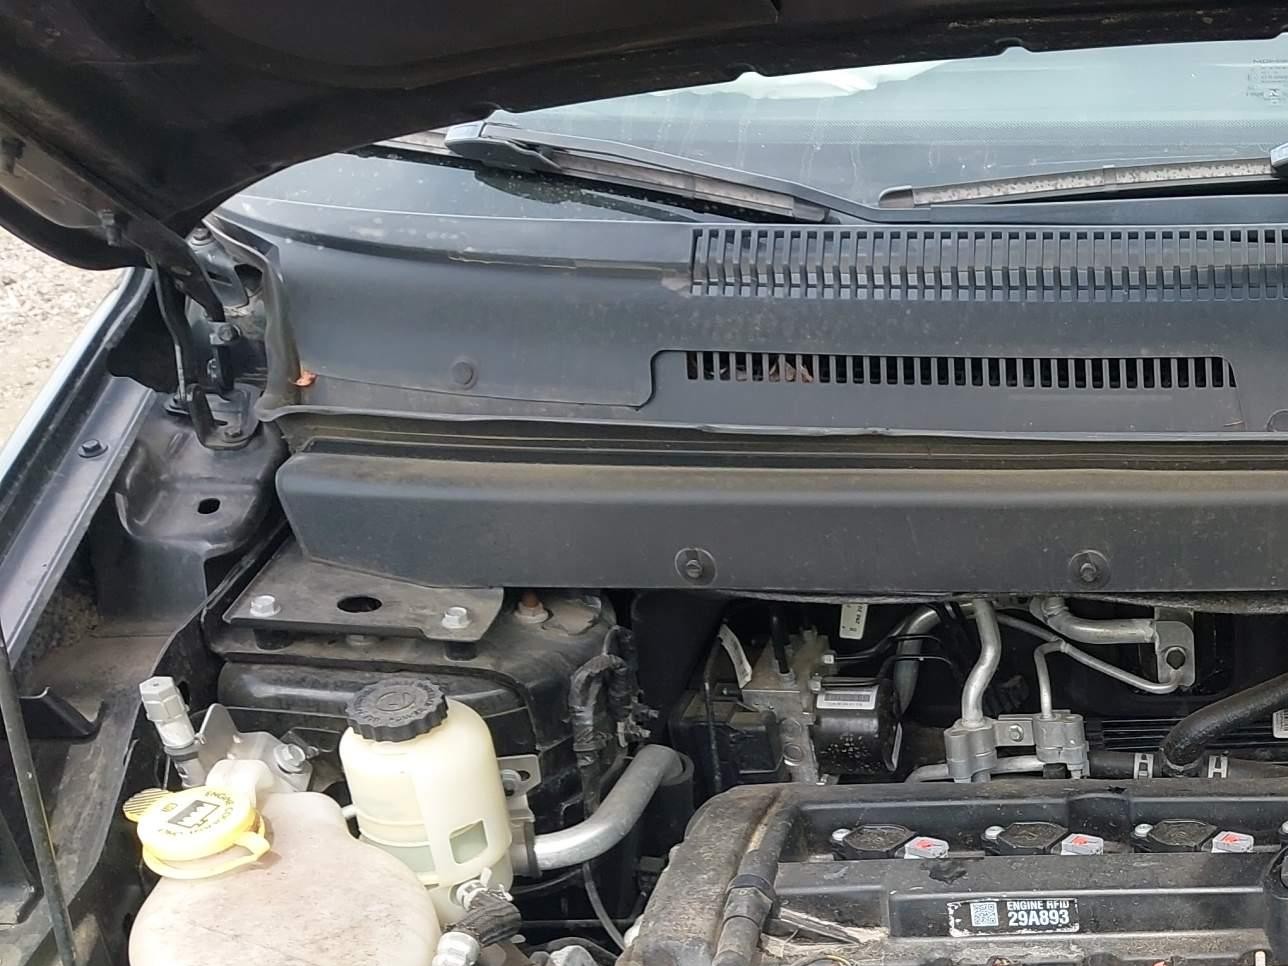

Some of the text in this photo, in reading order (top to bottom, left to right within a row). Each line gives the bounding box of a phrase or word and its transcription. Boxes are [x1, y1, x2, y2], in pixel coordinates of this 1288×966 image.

[1006, 900, 1070, 911] ENGINE RFID
[1007, 909, 1070, 927] 29A893
